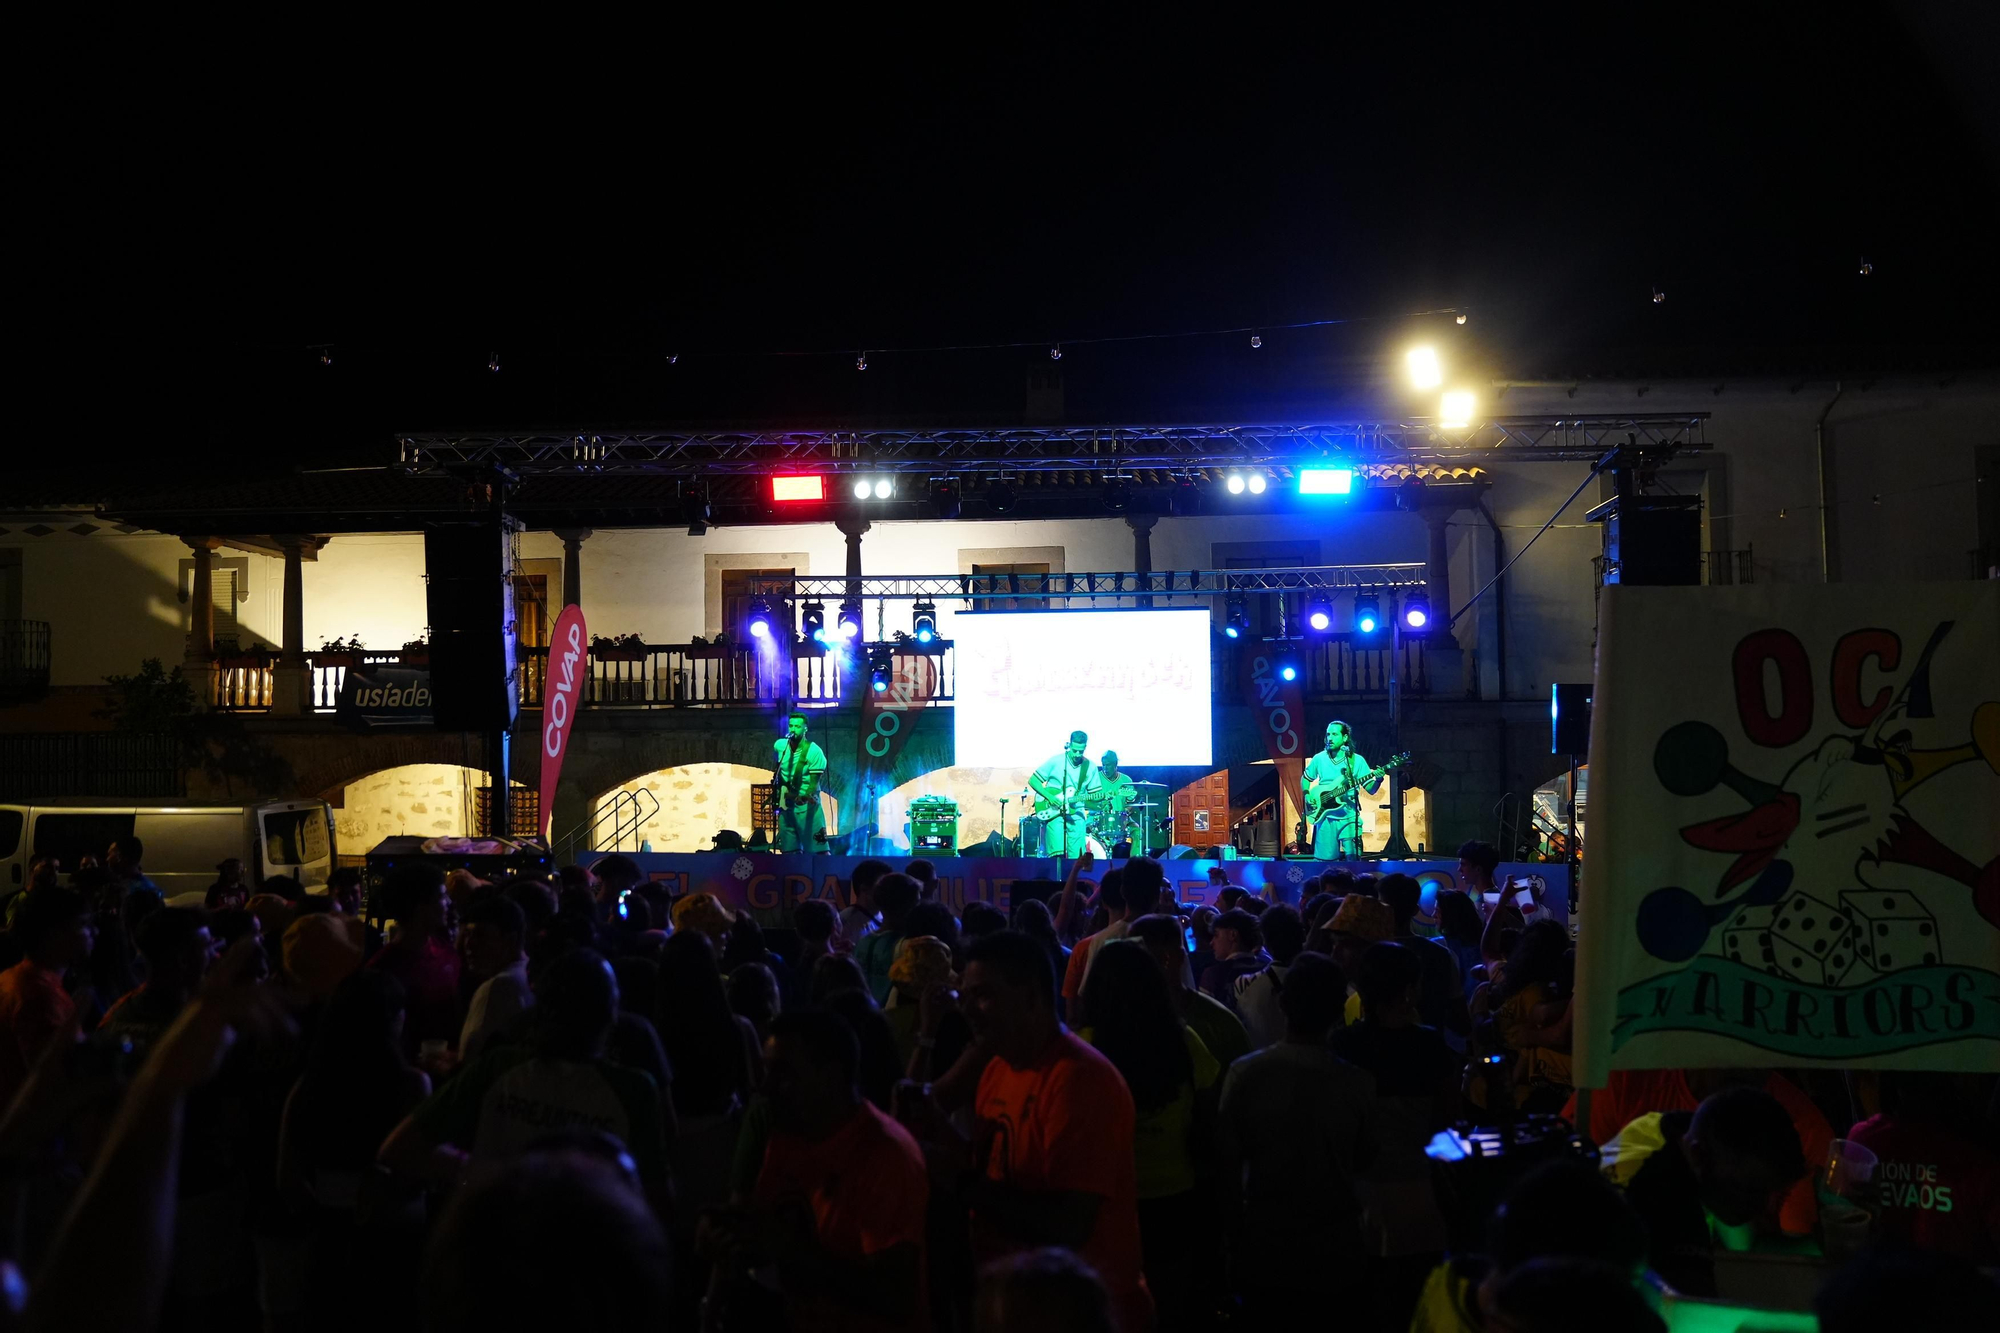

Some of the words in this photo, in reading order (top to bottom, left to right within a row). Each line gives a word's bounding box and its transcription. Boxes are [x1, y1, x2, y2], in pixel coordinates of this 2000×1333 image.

[545, 623, 581, 758] COVAP
[865, 661, 924, 757] COVAP
[746, 873, 858, 910] GRA
[1915, 1163, 1938, 1182] DE
